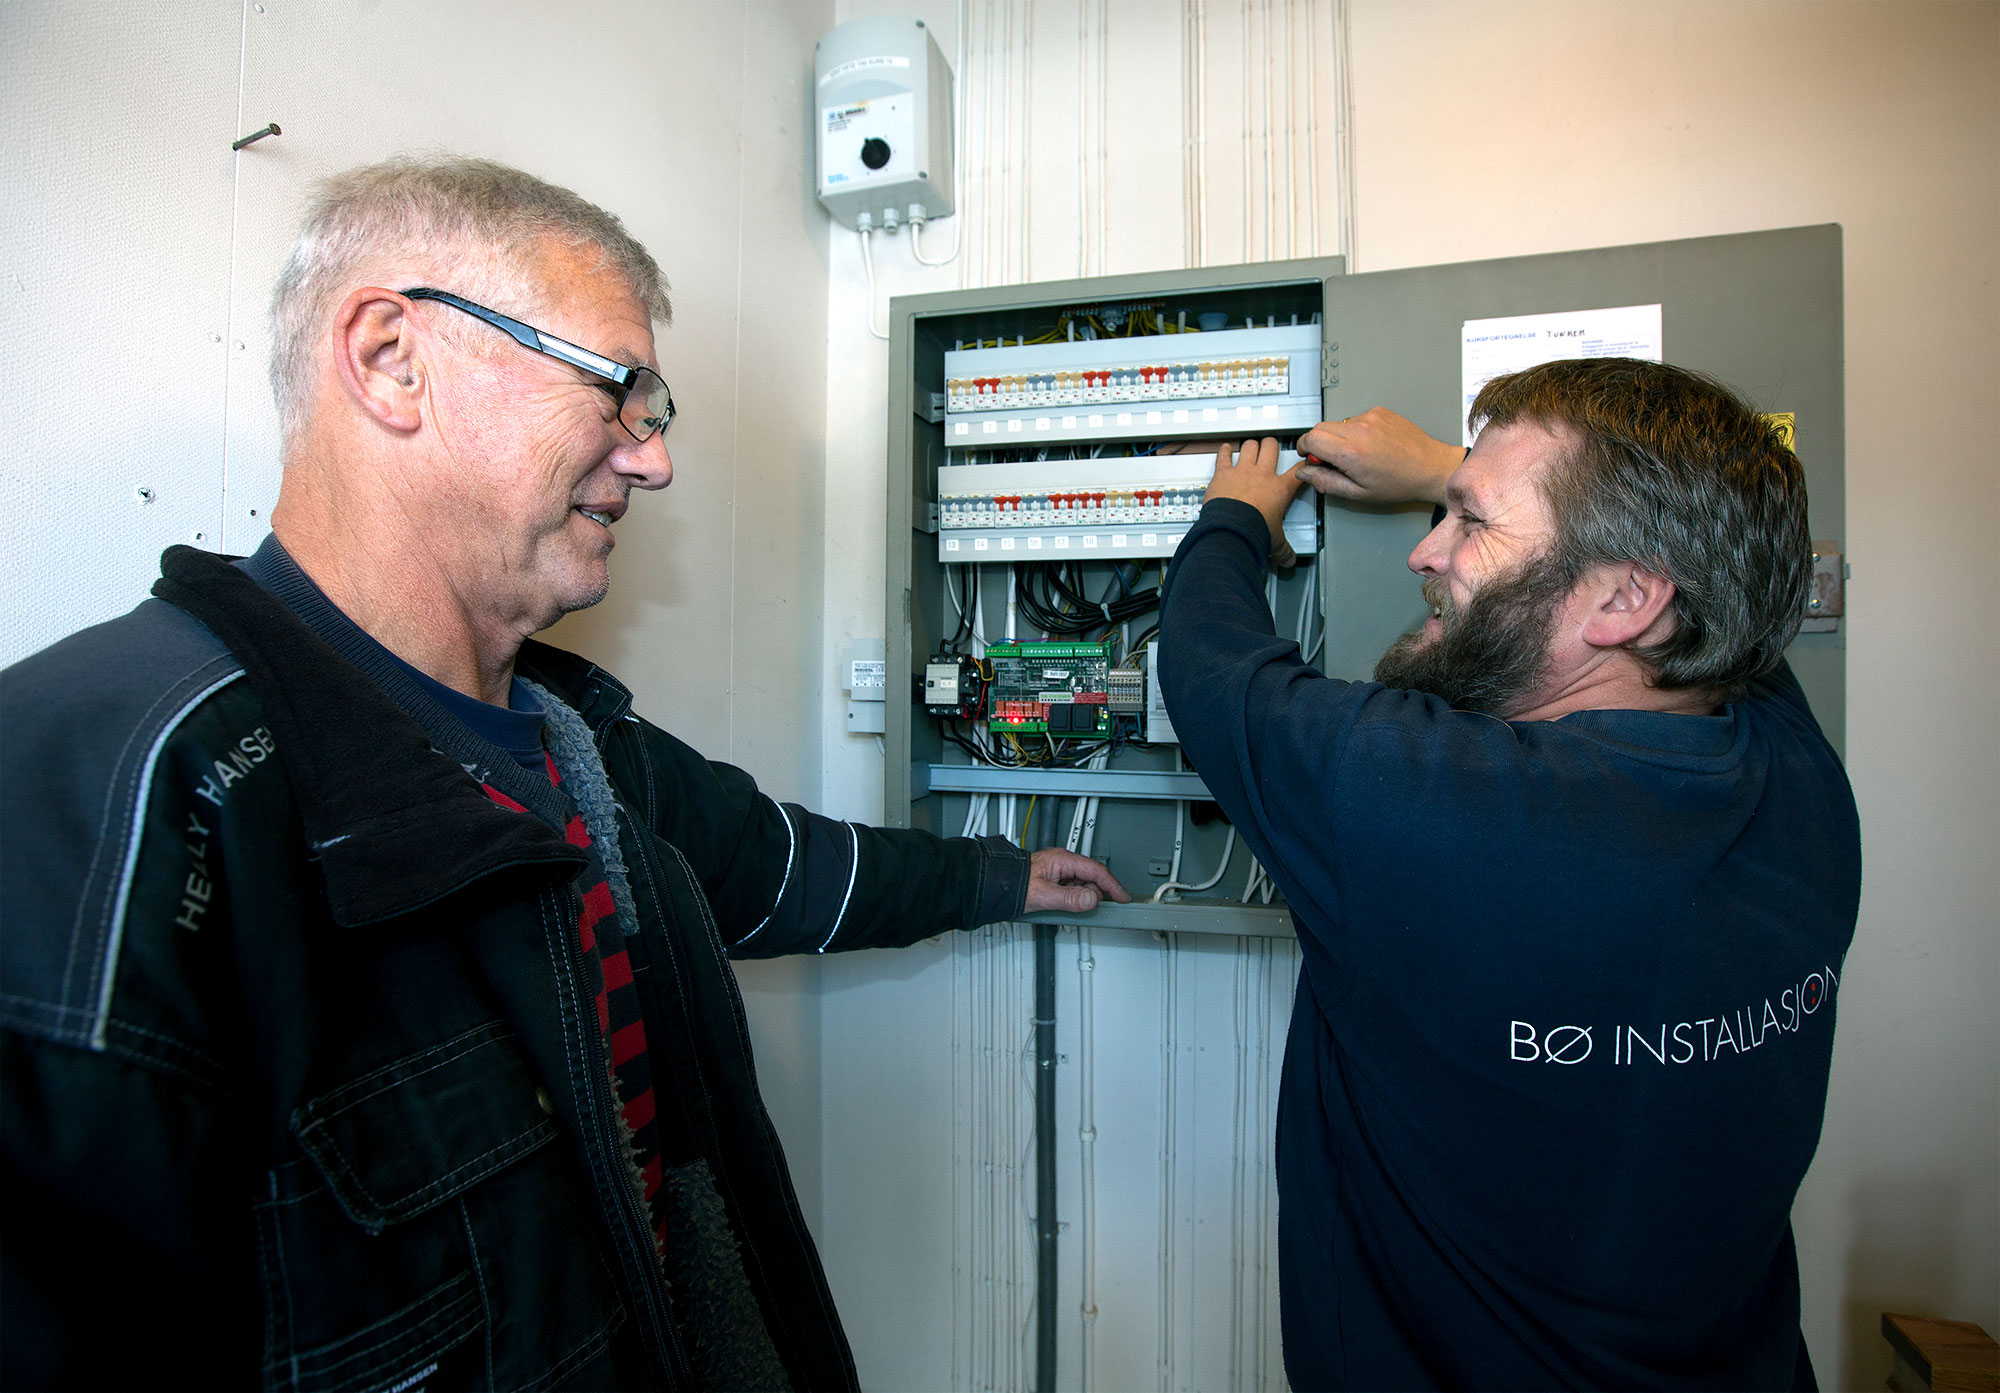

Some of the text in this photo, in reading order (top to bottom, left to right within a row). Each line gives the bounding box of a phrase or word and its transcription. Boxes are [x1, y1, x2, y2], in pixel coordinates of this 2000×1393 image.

[947, 541, 957, 549] 13
[976, 540, 985, 548] 14
[1057, 538, 1066, 546] 17
[1144, 535, 1155, 544] 20
[194, 724, 278, 807] HANSE
[1510, 1020, 1593, 1065] BØ
[391, 1361, 438, 1393] HANSEN
